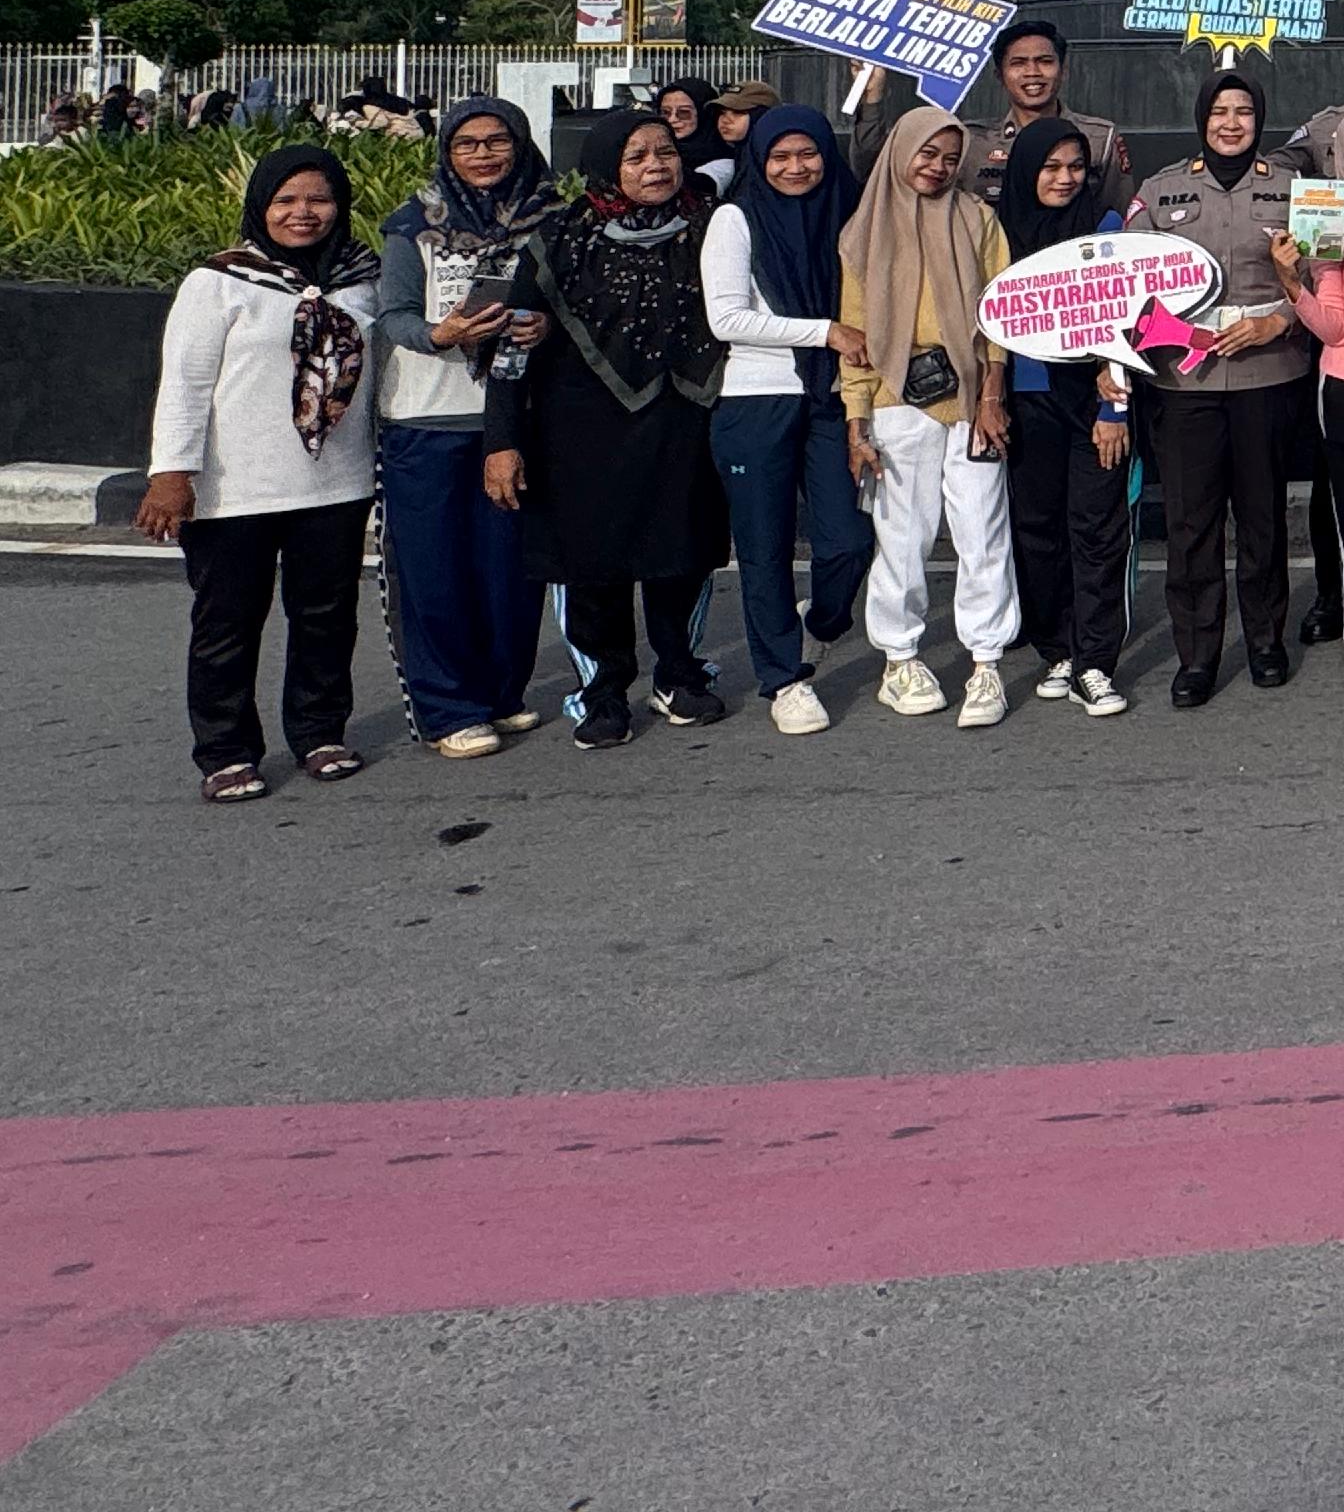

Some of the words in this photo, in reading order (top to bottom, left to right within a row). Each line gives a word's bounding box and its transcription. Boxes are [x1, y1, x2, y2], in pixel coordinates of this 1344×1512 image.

[898, 1, 993, 50] TERTIB
[1127, 9, 1188, 31] CERMIN
[1200, 14, 1265, 36] BUDAYA
[1276, 19, 1324, 39] MAJU
[883, 32, 980, 79] LINTAS
[1159, 193, 1200, 206] RIZA
[984, 274, 1138, 321] MASYARAKAT
[1144, 263, 1208, 293] BIJAK
[997, 268, 1078, 295] MASYARAKAT
[1132, 255, 1161, 272] STOP
[1163, 251, 1194, 268] HOAX
[1000, 313, 1055, 338] TERTIB
[1060, 300, 1128, 329] BERLALU
[1061, 325, 1116, 351] LINTAS
